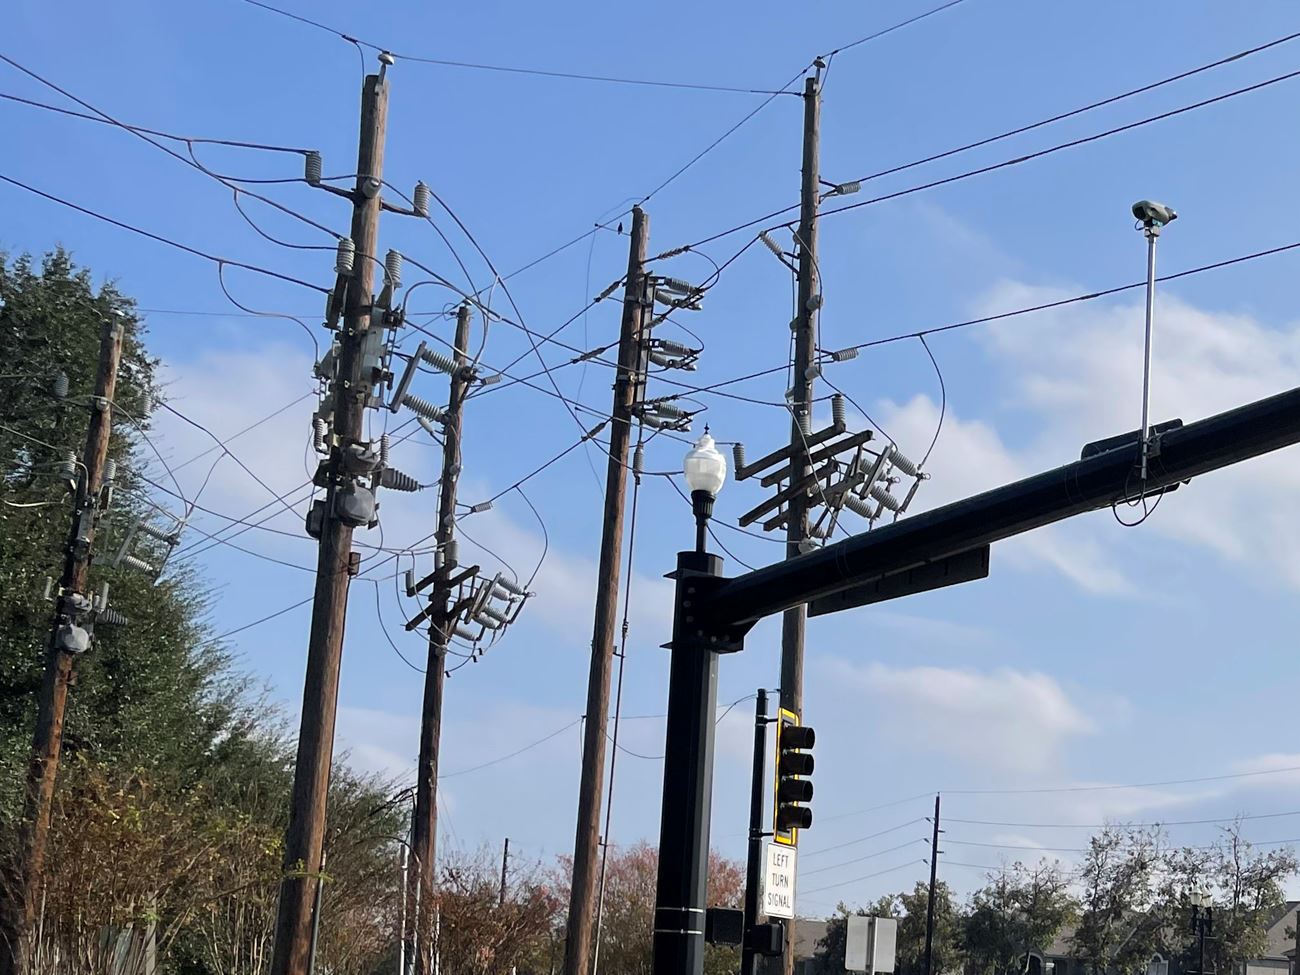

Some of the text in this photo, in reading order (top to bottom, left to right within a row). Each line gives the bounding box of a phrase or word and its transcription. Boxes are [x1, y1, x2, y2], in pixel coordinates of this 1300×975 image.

[773, 853, 788, 868] LEFT
[772, 873, 788, 888] TURN
[768, 893, 790, 908] SIGNAL
